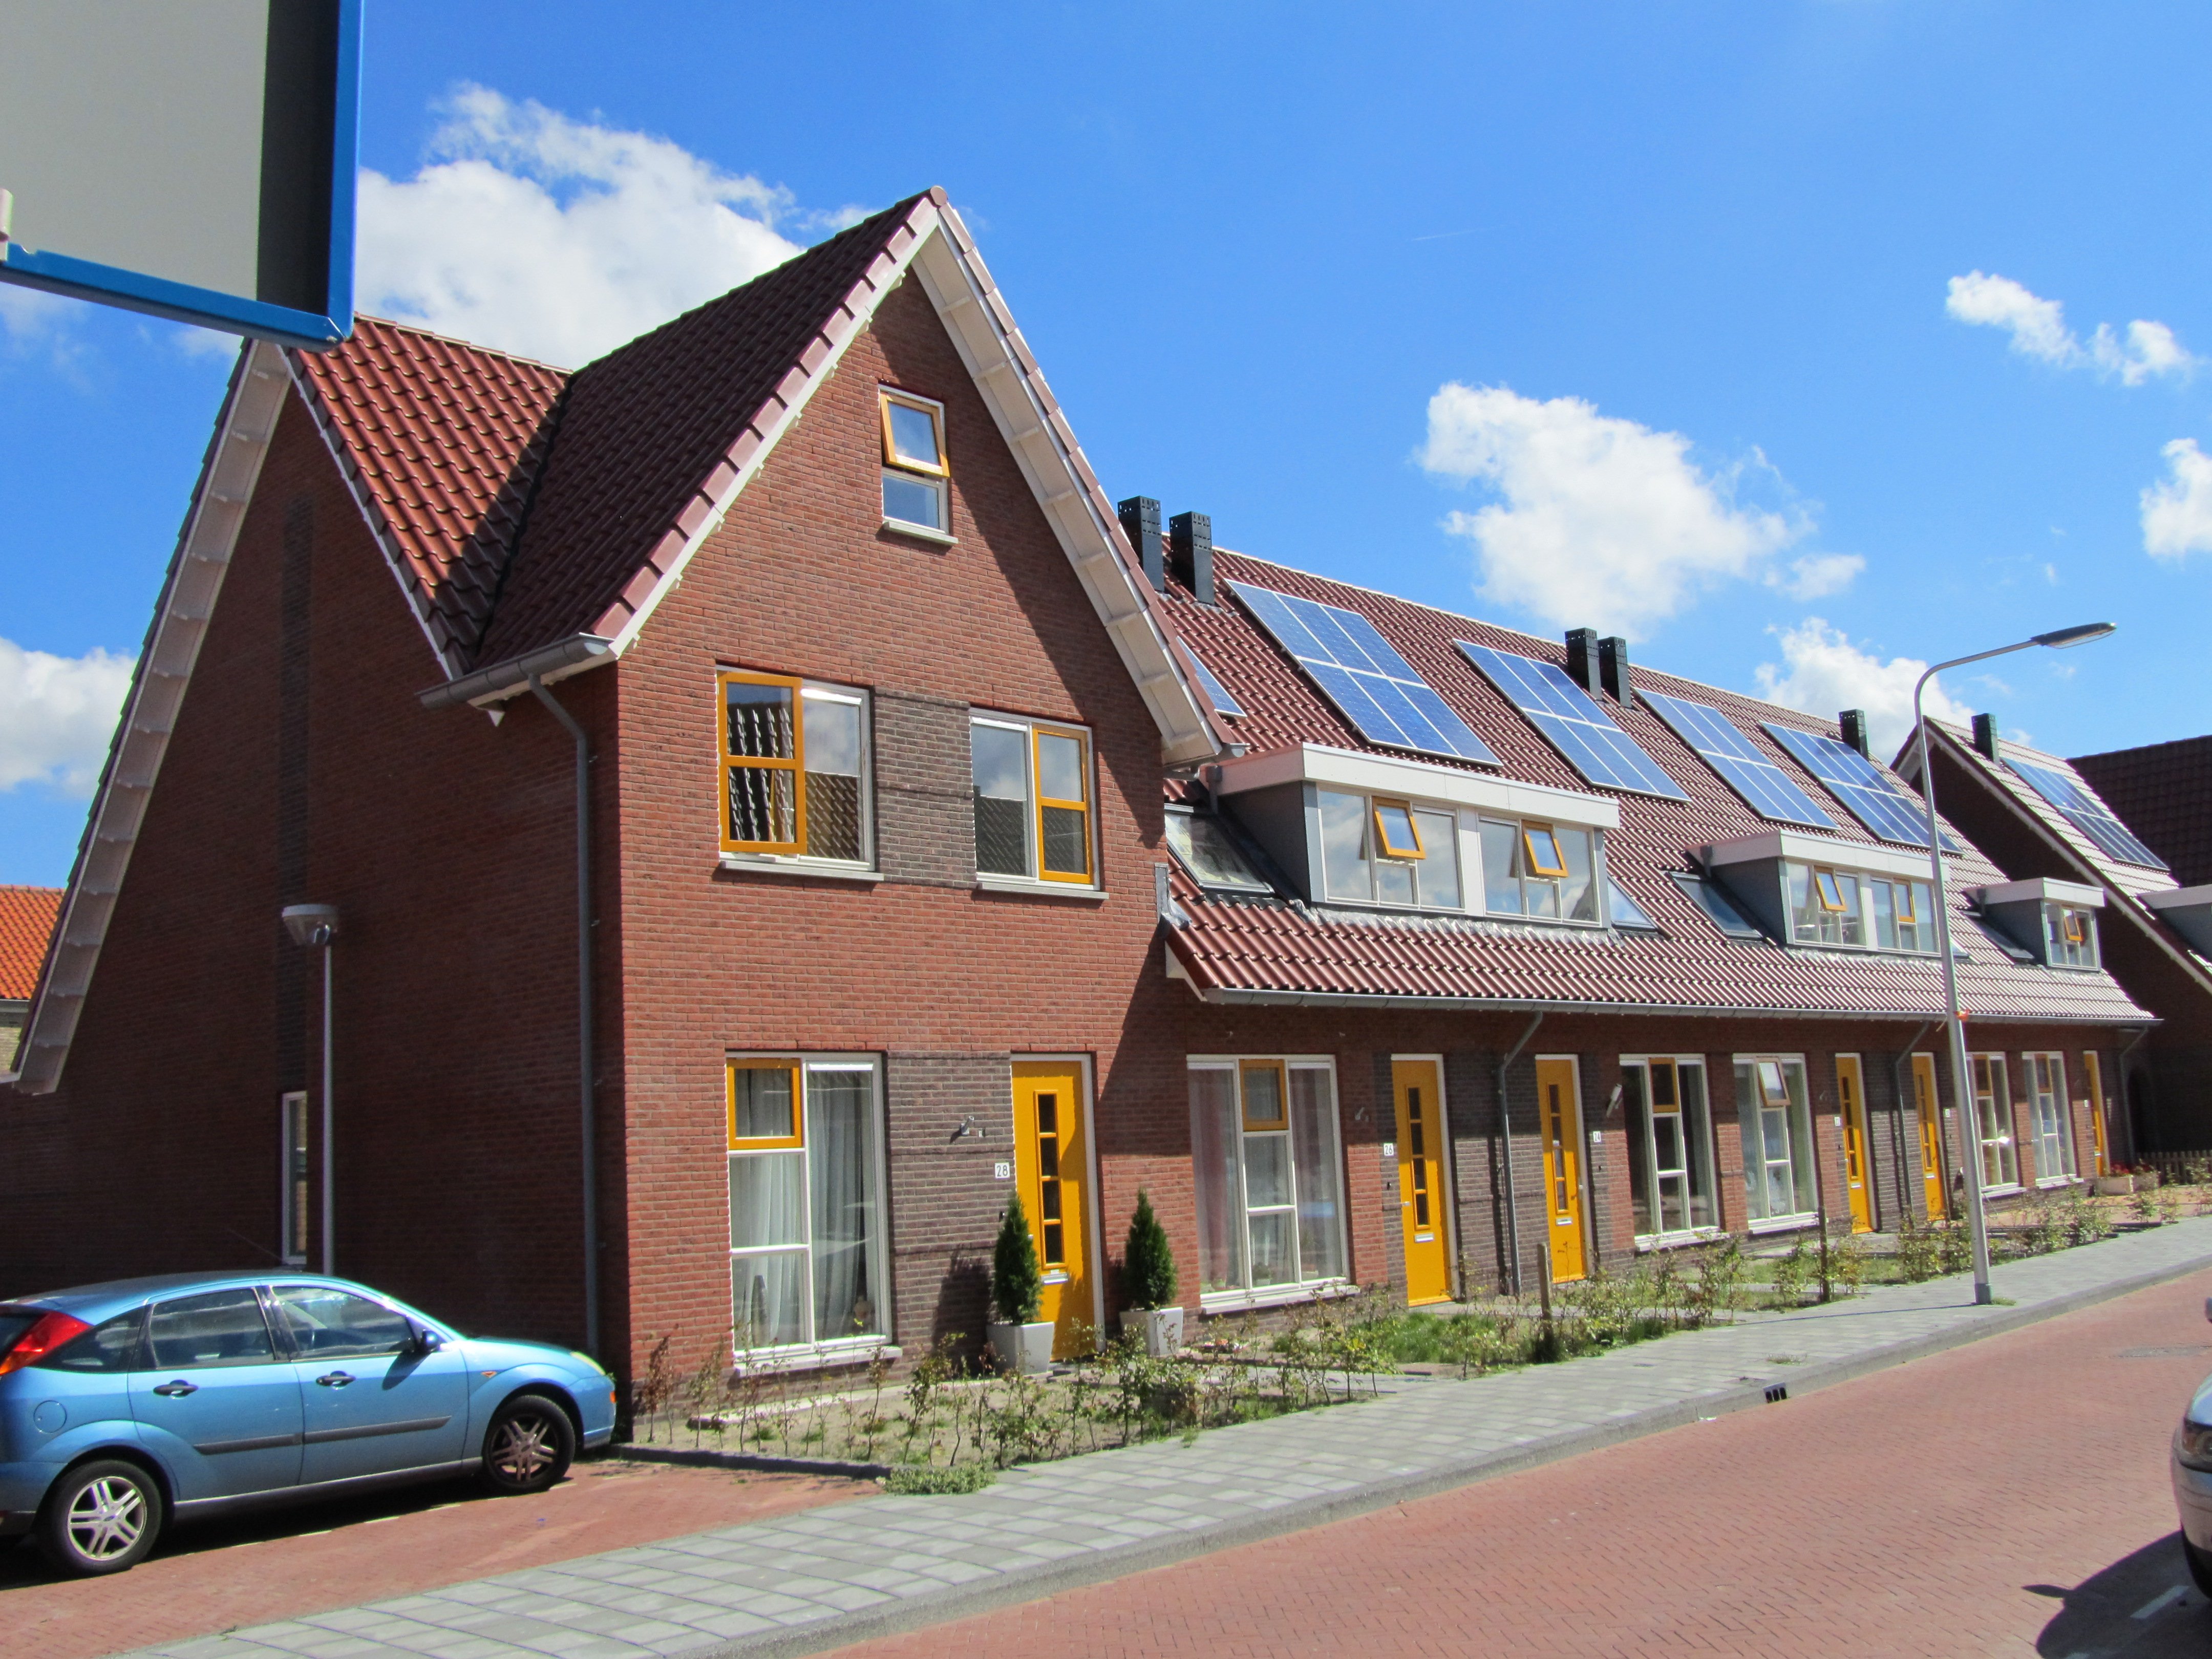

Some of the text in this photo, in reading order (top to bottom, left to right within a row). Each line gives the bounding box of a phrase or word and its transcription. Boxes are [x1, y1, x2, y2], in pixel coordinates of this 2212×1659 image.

[1594, 1133, 1600, 1141] 24
[1385, 1145, 1393, 1155] 26
[996, 1165, 1008, 1177] 28
